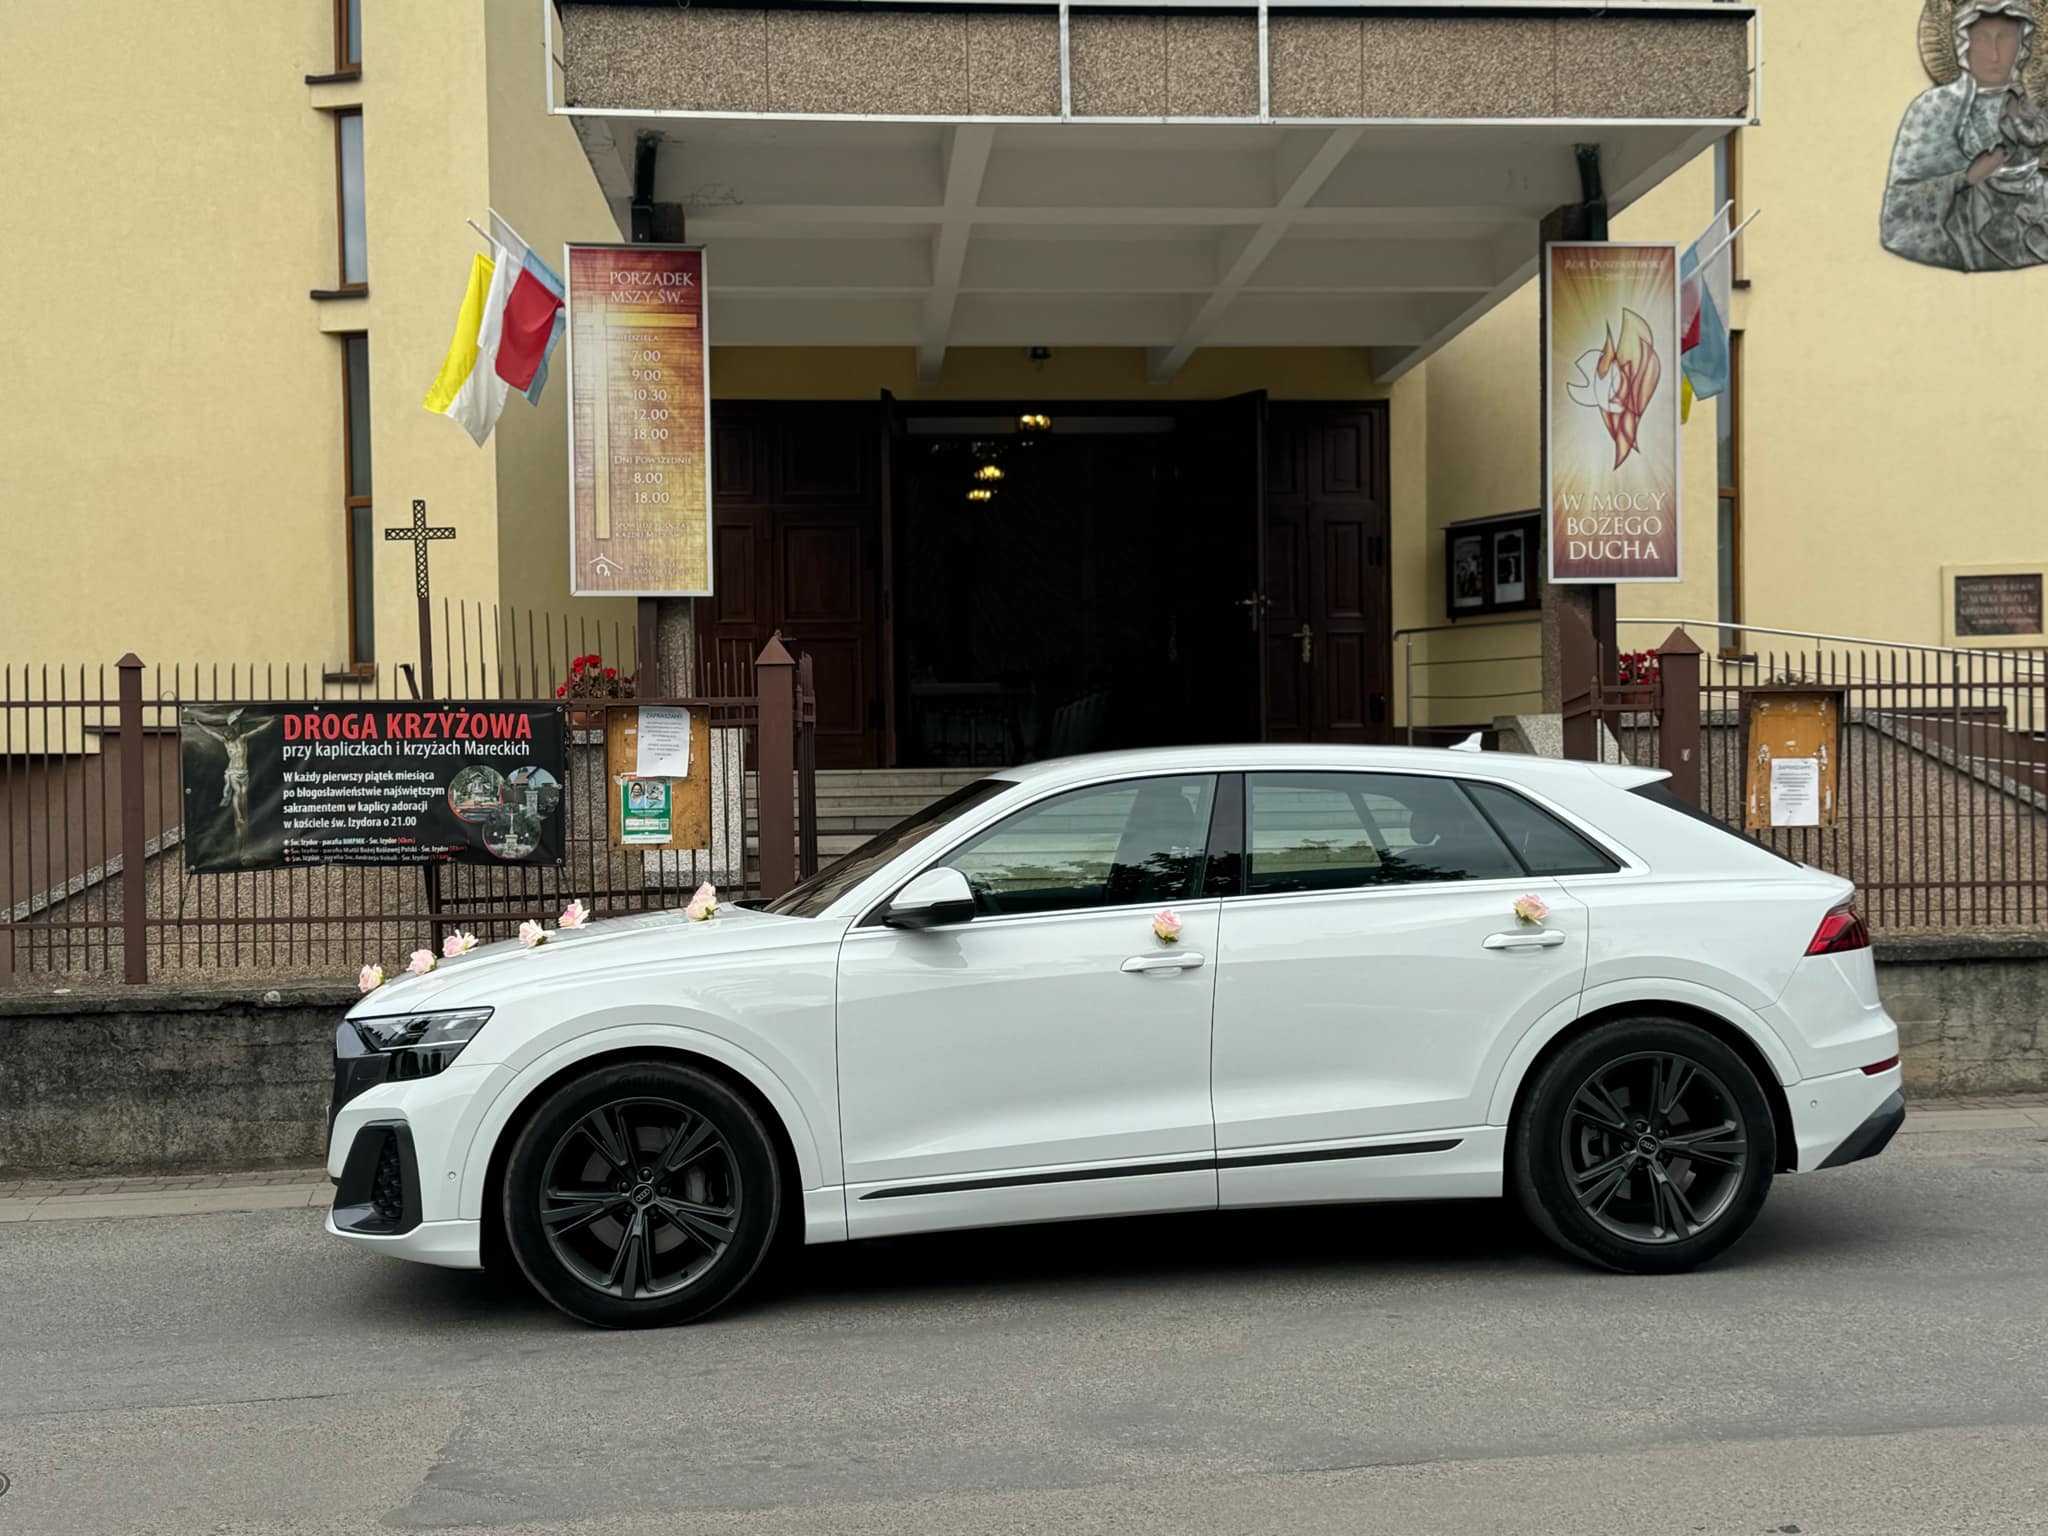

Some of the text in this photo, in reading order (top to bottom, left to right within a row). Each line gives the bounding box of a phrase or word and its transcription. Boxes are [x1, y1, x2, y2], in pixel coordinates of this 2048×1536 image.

[610, 290, 654, 304] MSZY
[631, 349, 661, 361] 7.00
[631, 369, 662, 381] 9.00
[633, 388, 667, 401] 10.30
[633, 408, 669, 421] 12.00
[634, 427, 669, 441] 18.00
[634, 472, 663, 484] 8.00
[635, 491, 670, 504] 18.00
[1561, 491, 1666, 512] W MOCY
[1567, 513, 1662, 536] BOŻEGO
[1568, 540, 1660, 560] DUCHA
[283, 706, 532, 740] DROGA KRZYŻOWA
[282, 740, 530, 760] przy kapliczkach i krzyżach Mareckich
[283, 770, 435, 784] W każdy pierwszy piątek miesiąca
[283, 785, 445, 800] po błogosławieństwie najświętszym
[283, 801, 428, 814] sakramentem w kaplicy adoracji
[283, 816, 417, 829] w kościele św. Izydora o 21.00
